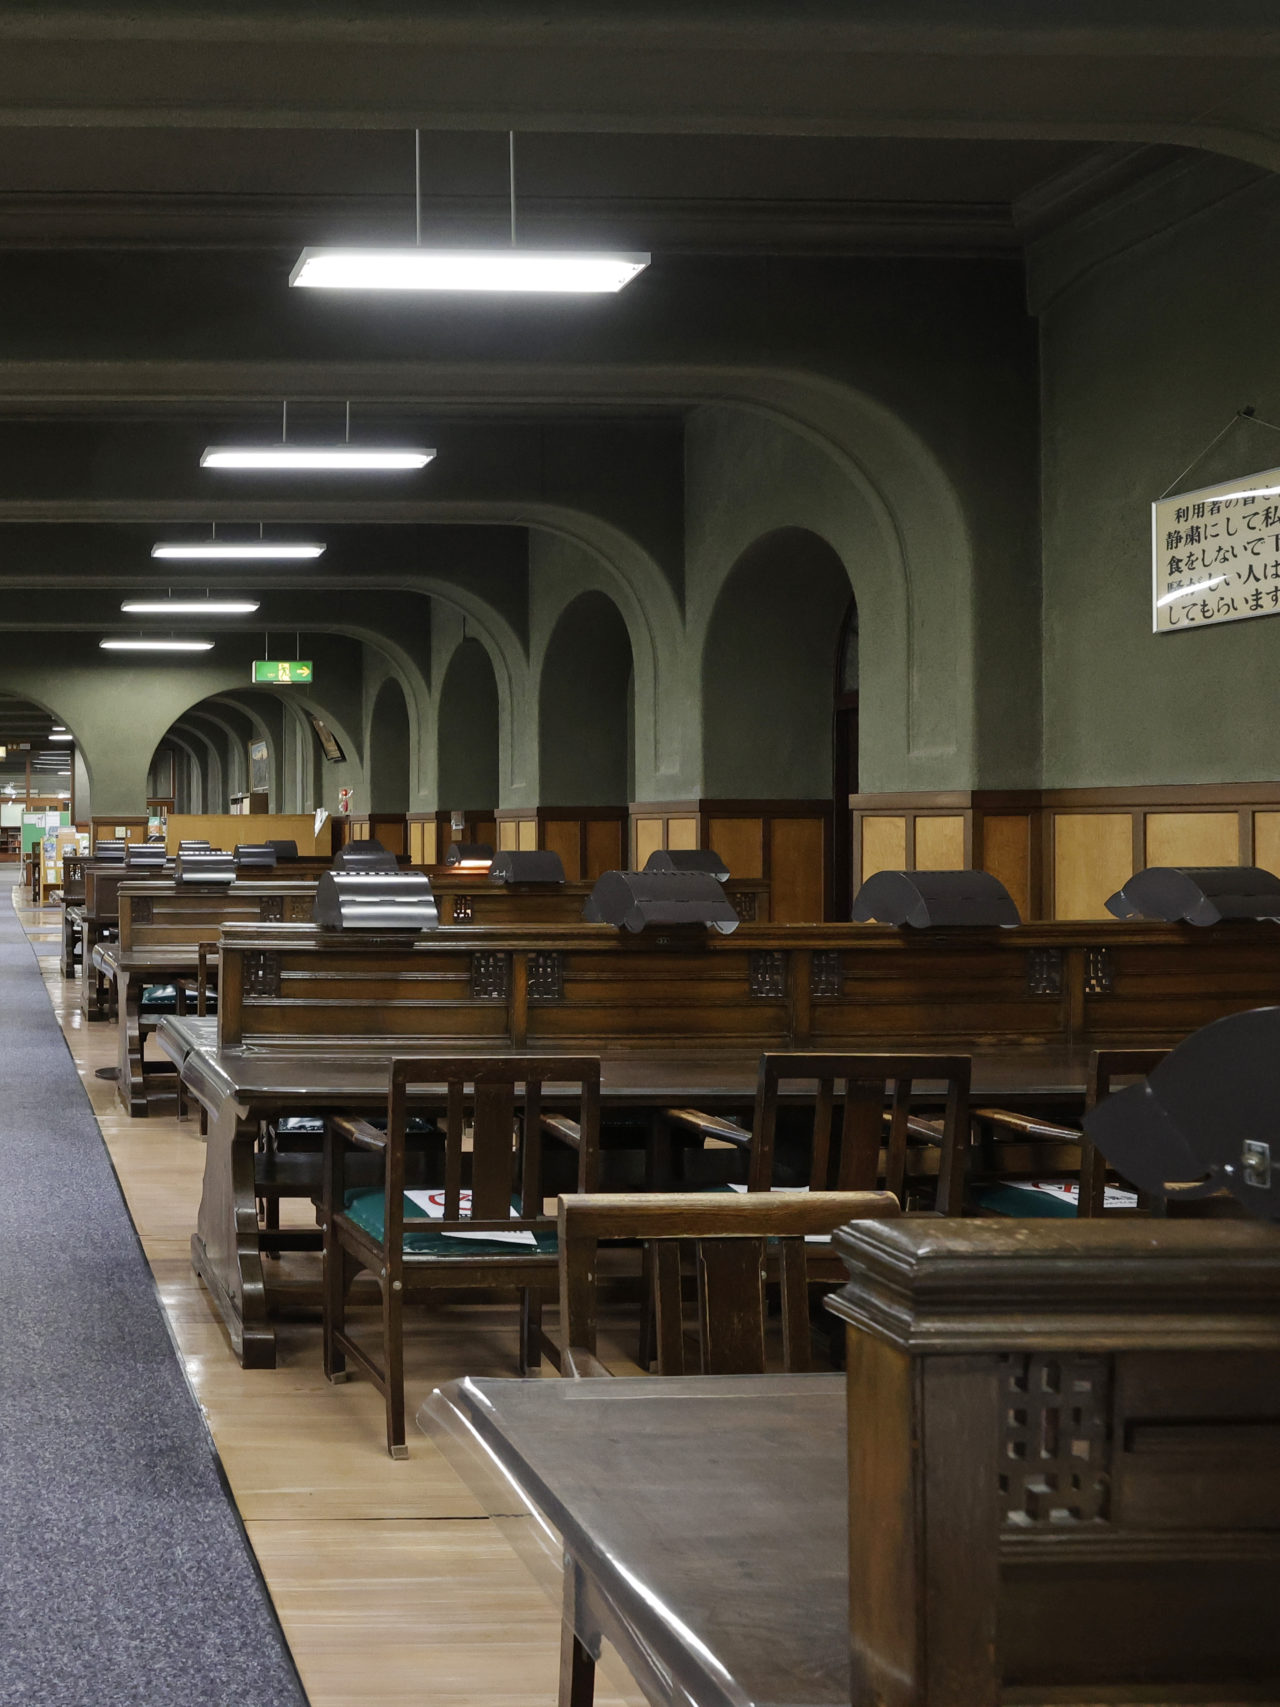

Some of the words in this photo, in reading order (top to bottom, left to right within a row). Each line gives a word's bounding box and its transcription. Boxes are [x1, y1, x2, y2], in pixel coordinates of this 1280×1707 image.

[1168, 586, 1280, 625] してもらいます
